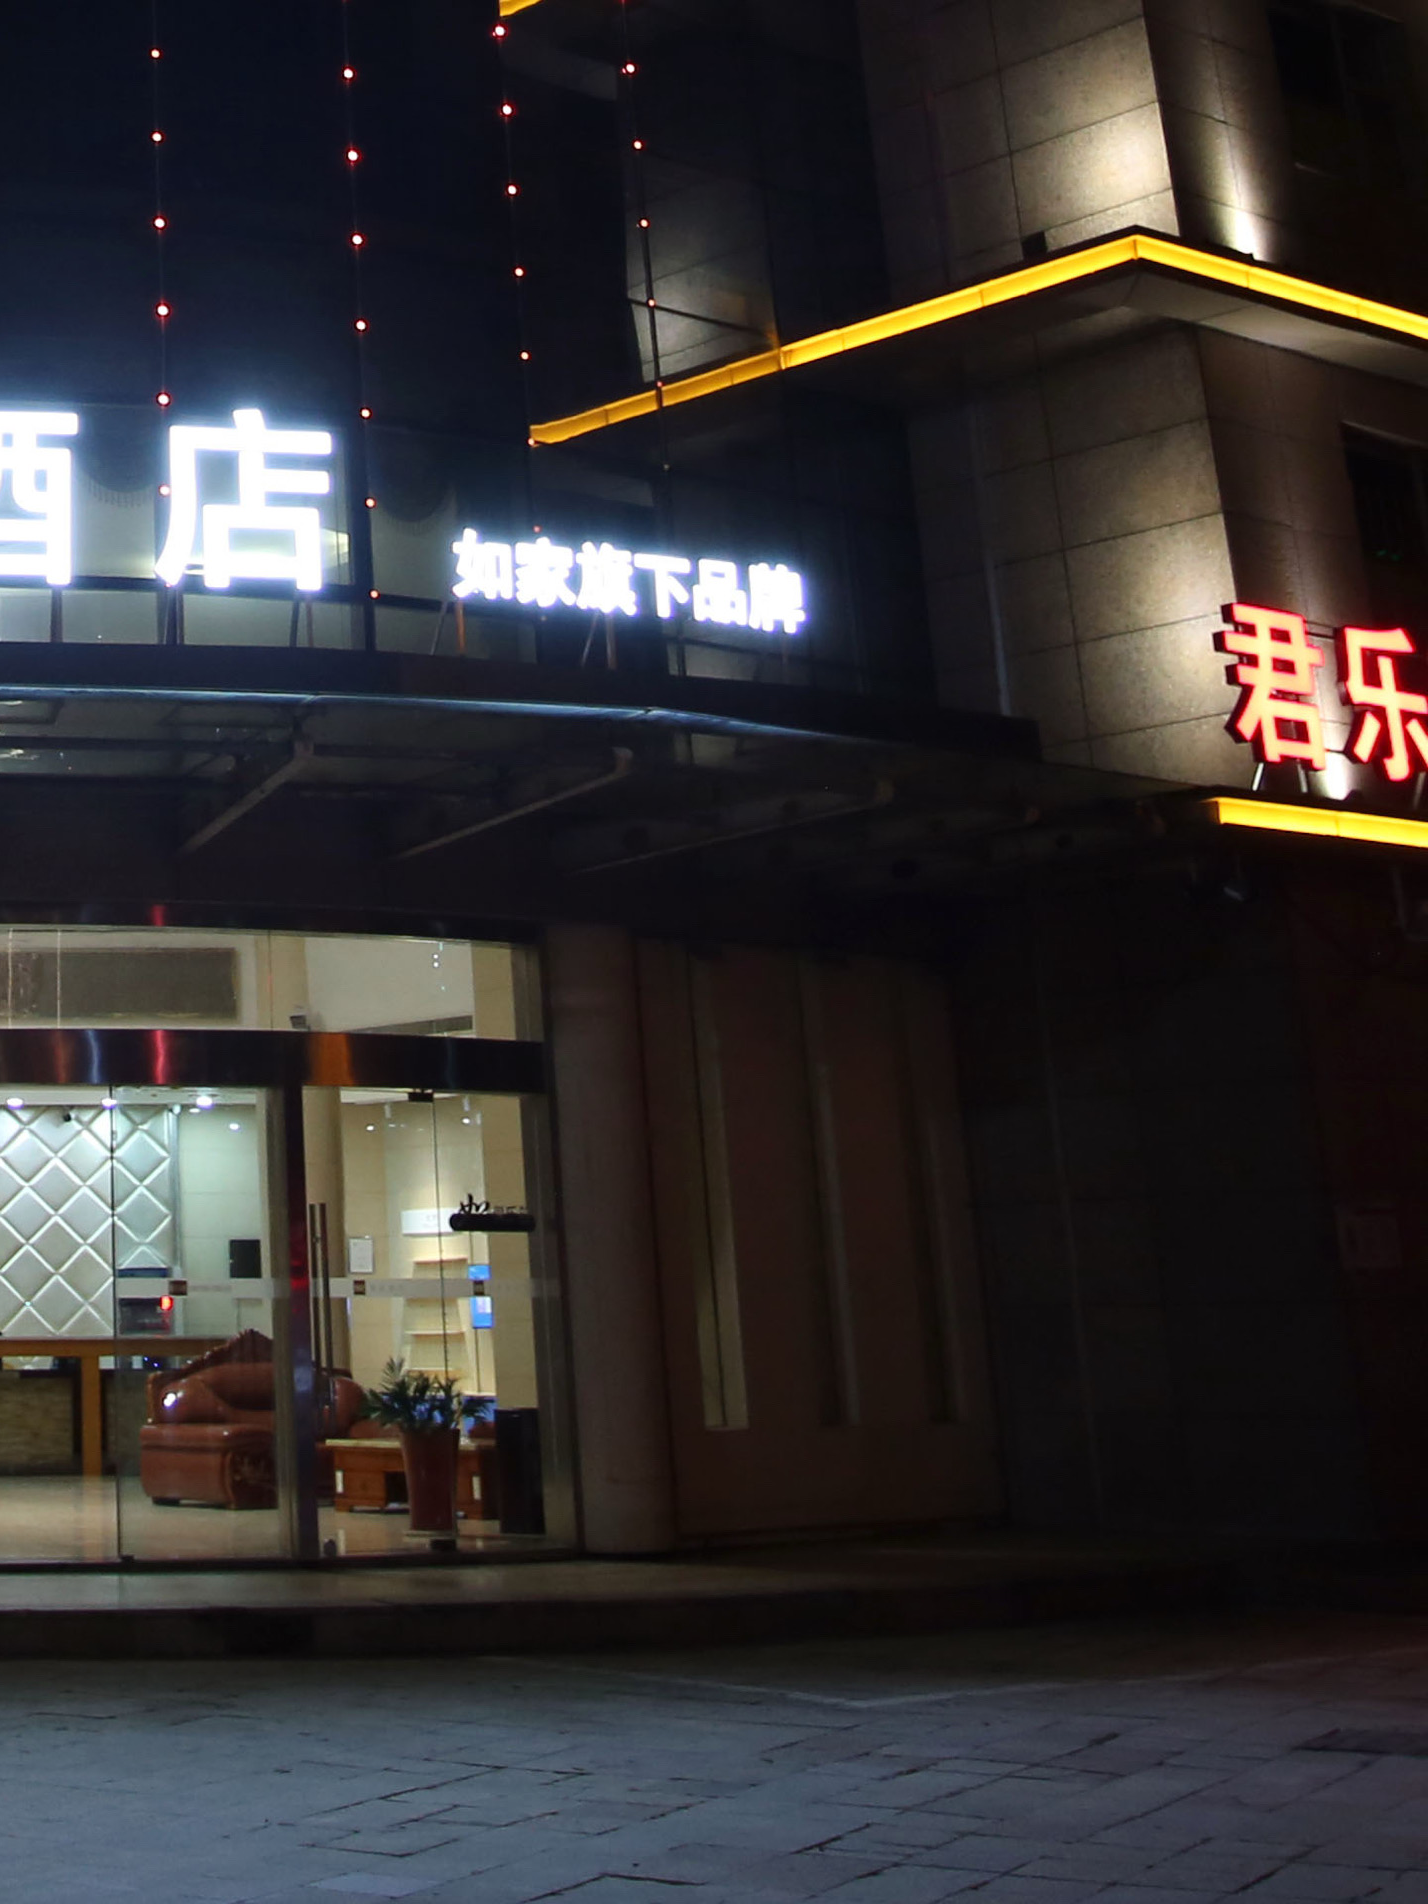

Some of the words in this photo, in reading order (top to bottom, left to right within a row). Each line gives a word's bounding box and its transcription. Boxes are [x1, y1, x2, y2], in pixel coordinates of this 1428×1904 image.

[452, 528, 807, 634] 如家旗下品牌
[1218, 602, 1428, 781] 君乐
